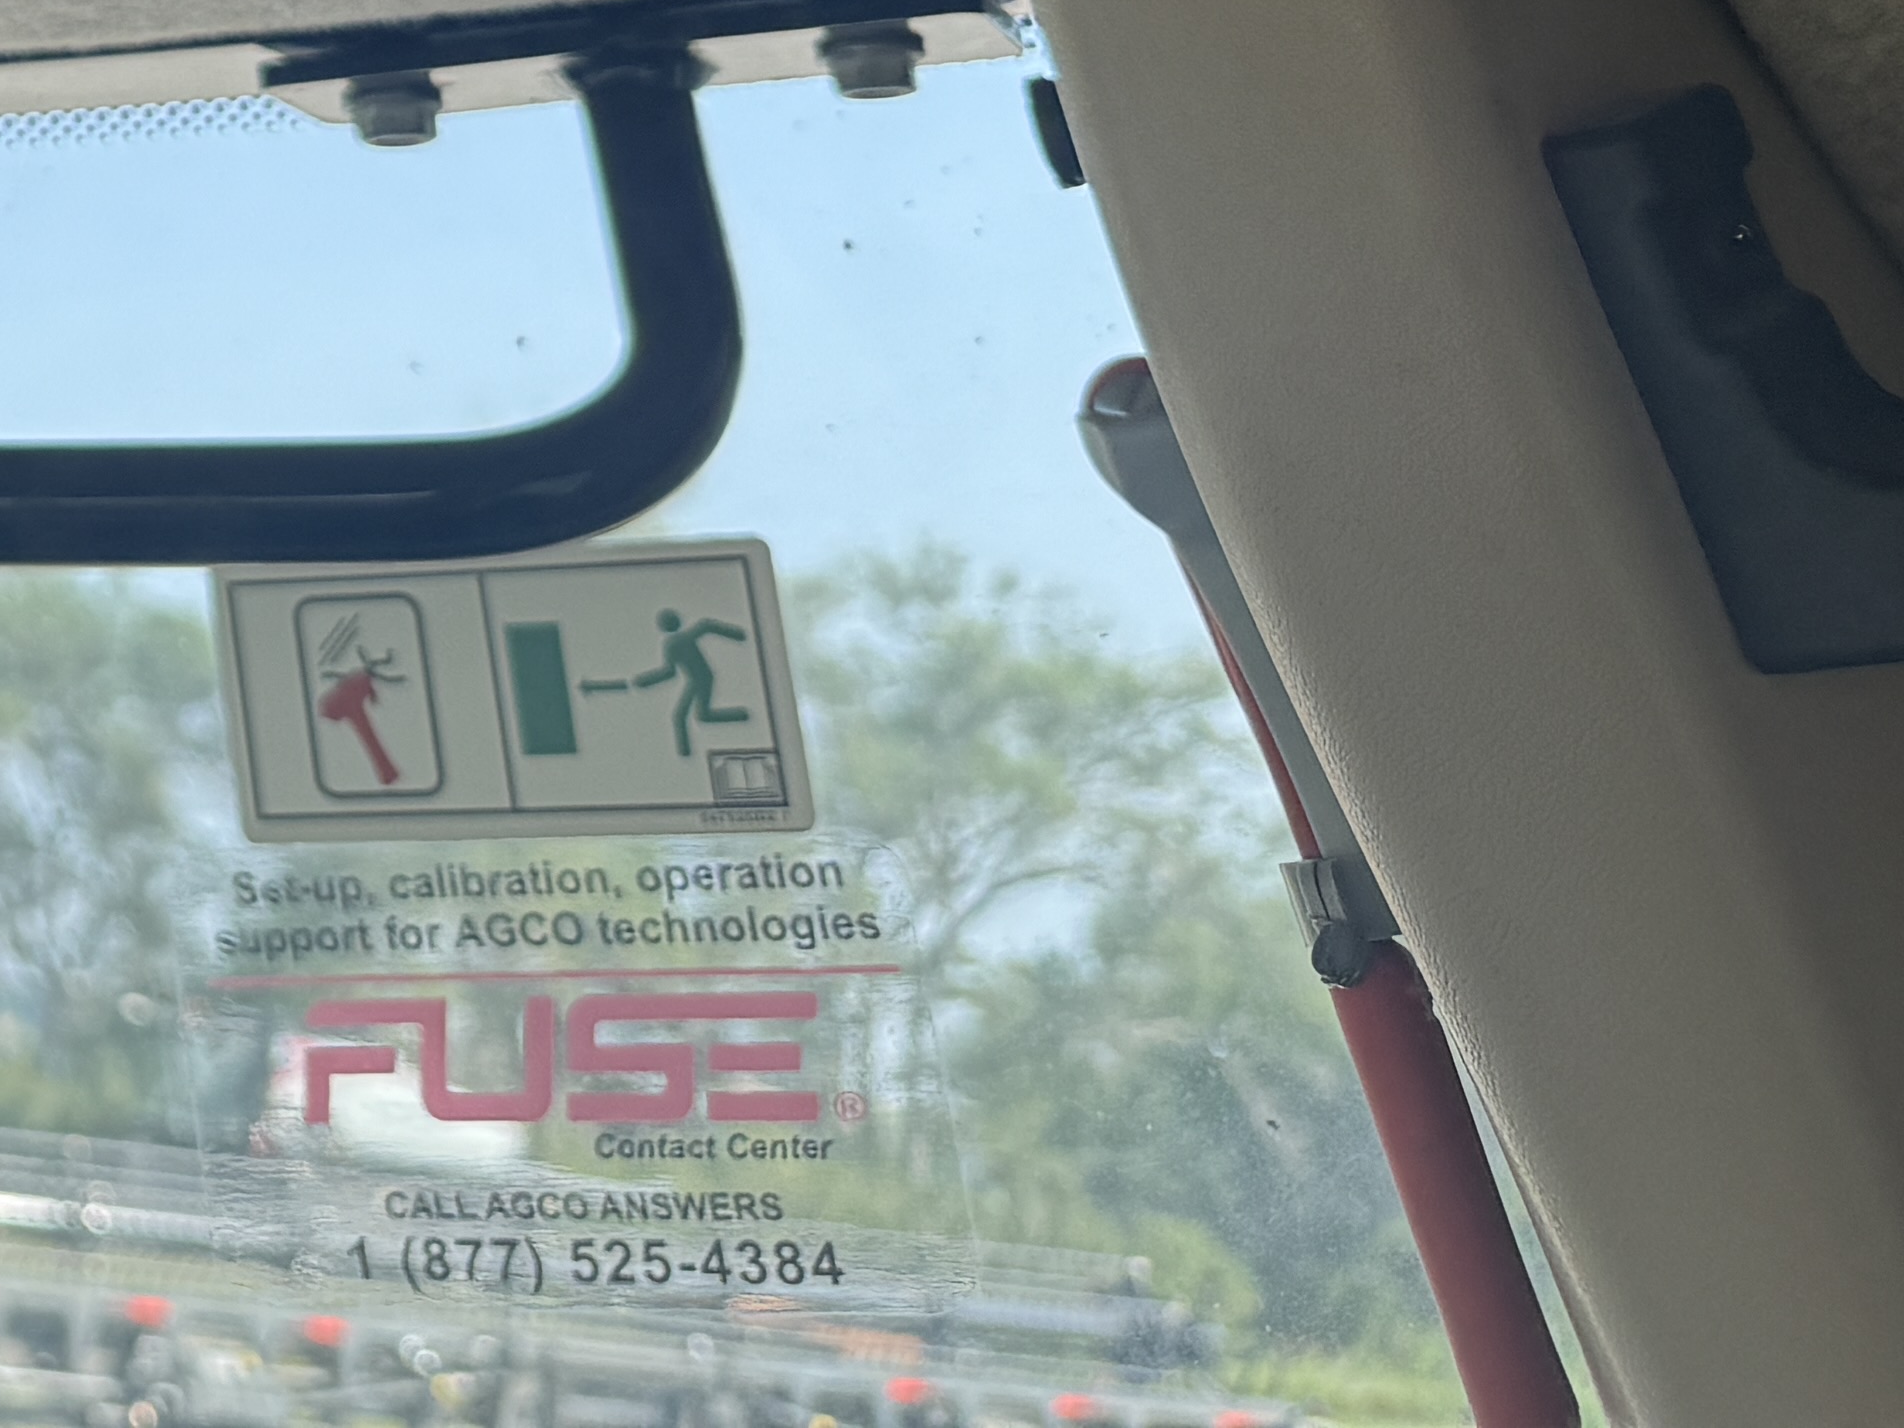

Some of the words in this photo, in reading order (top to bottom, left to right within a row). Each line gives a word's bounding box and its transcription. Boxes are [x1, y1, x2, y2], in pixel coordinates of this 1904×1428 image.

[232, 869, 375, 909] Set-up,
[389, 860, 623, 900] calibration,
[636, 853, 845, 901] operation
[214, 918, 371, 961] support
[385, 914, 441, 950] for
[456, 910, 584, 947] AGCO
[597, 905, 882, 950] technologies
[594, 1132, 715, 1159] Contact
[727, 1132, 834, 1160] Center
[385, 1190, 480, 1220] CALL
[484, 1191, 589, 1220] AGCO
[600, 1191, 784, 1221] ANSWERS
[347, 1235, 372, 1280] 1
[400, 1235, 543, 1295] (877)
[570, 1238, 846, 1286] 525-4384
